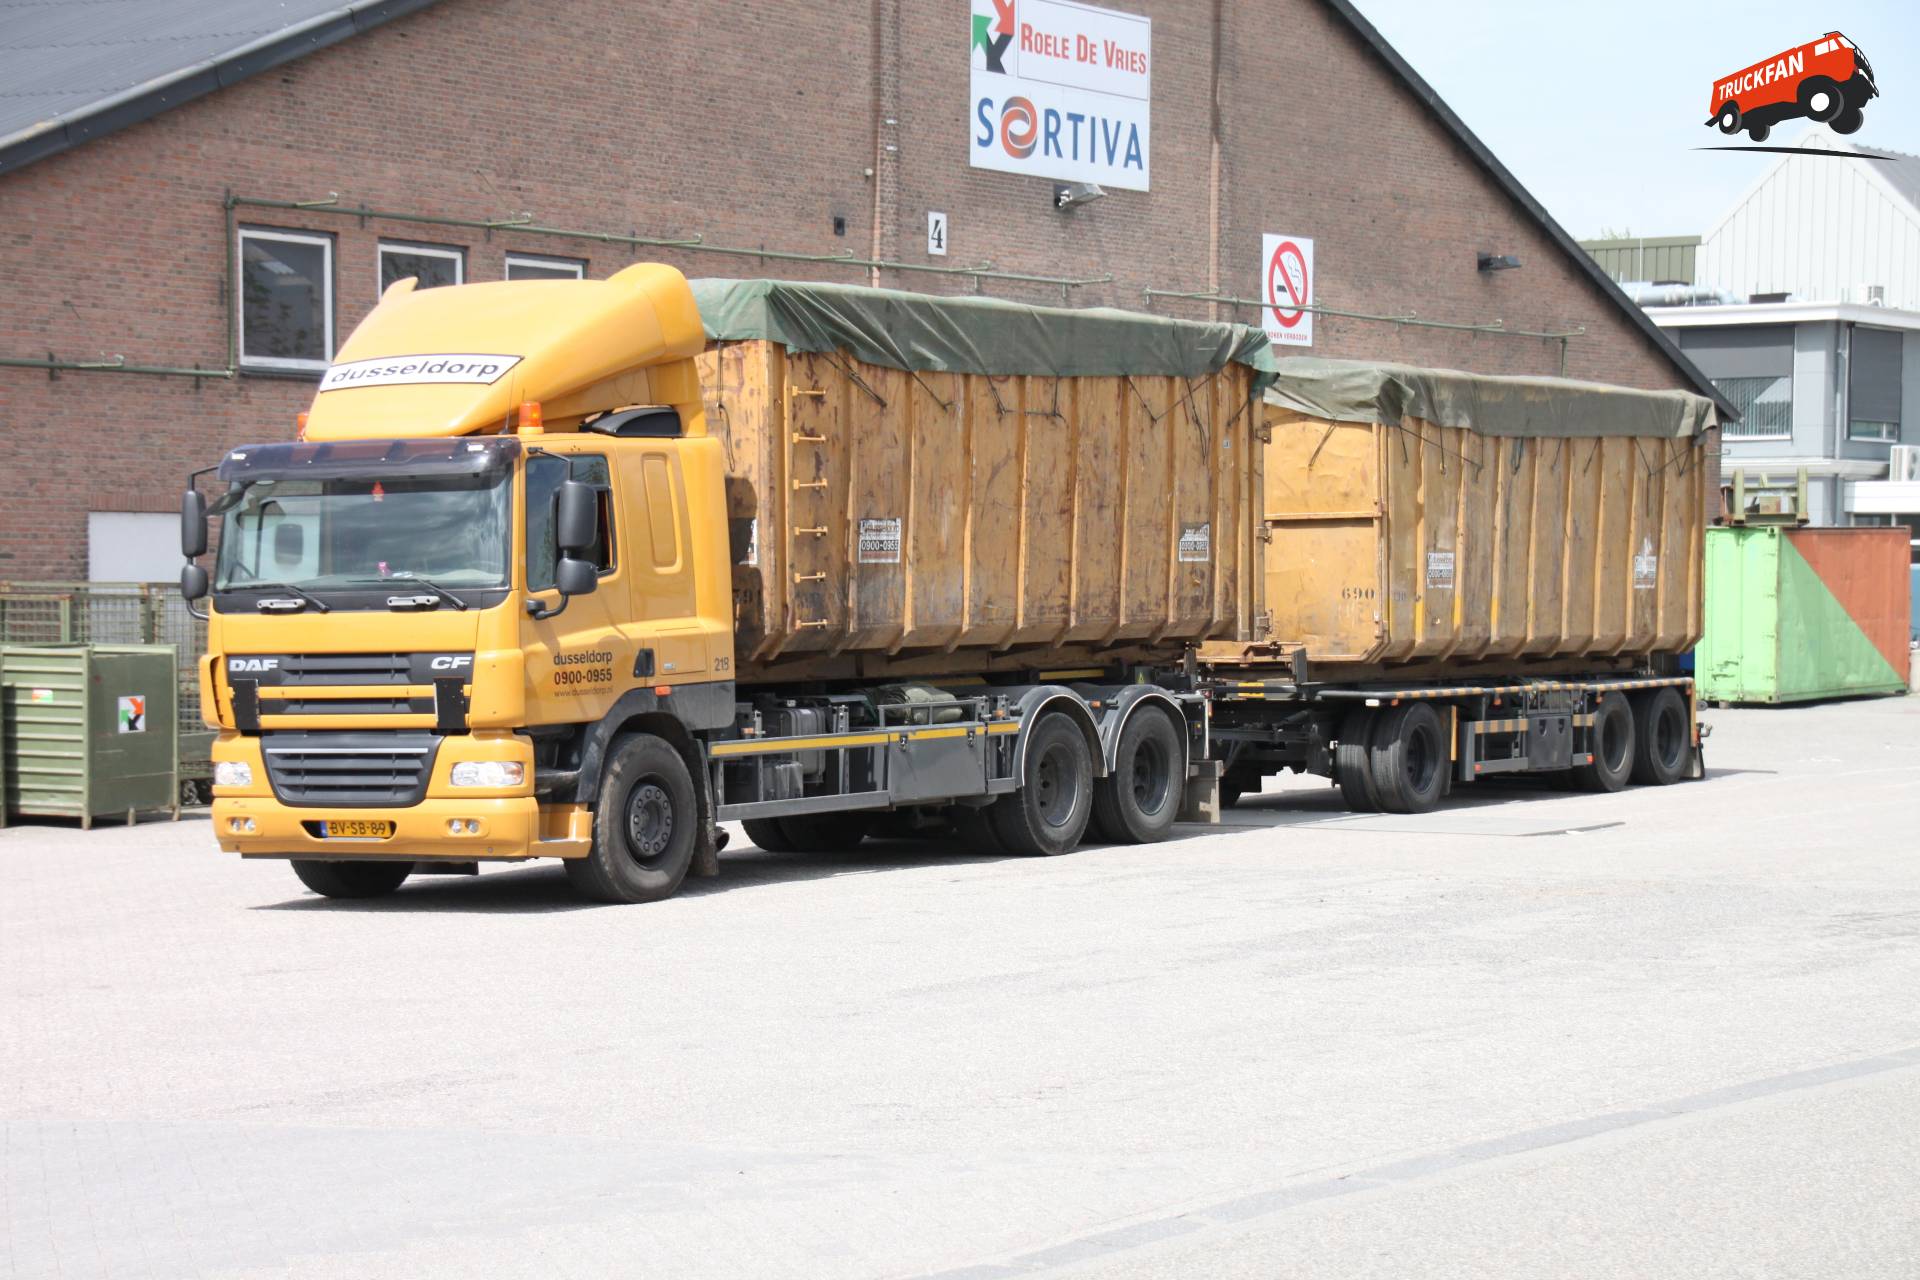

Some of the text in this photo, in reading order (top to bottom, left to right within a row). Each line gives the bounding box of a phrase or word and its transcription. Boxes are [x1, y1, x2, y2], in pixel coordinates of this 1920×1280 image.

[1020, 22, 1147, 75] ROELE DE VRIES
[976, 95, 1144, 170] SORTIVA
[930, 219, 943, 249] 4
[331, 360, 499, 384] dusseldorp
[1341, 586, 1375, 600] 690
[229, 659, 279, 672] DAF
[431, 656, 472, 670] CF
[553, 651, 613, 666] dusseldorp
[554, 668, 613, 685] 0900-0955
[329, 822, 387, 835] BV-SB-89
